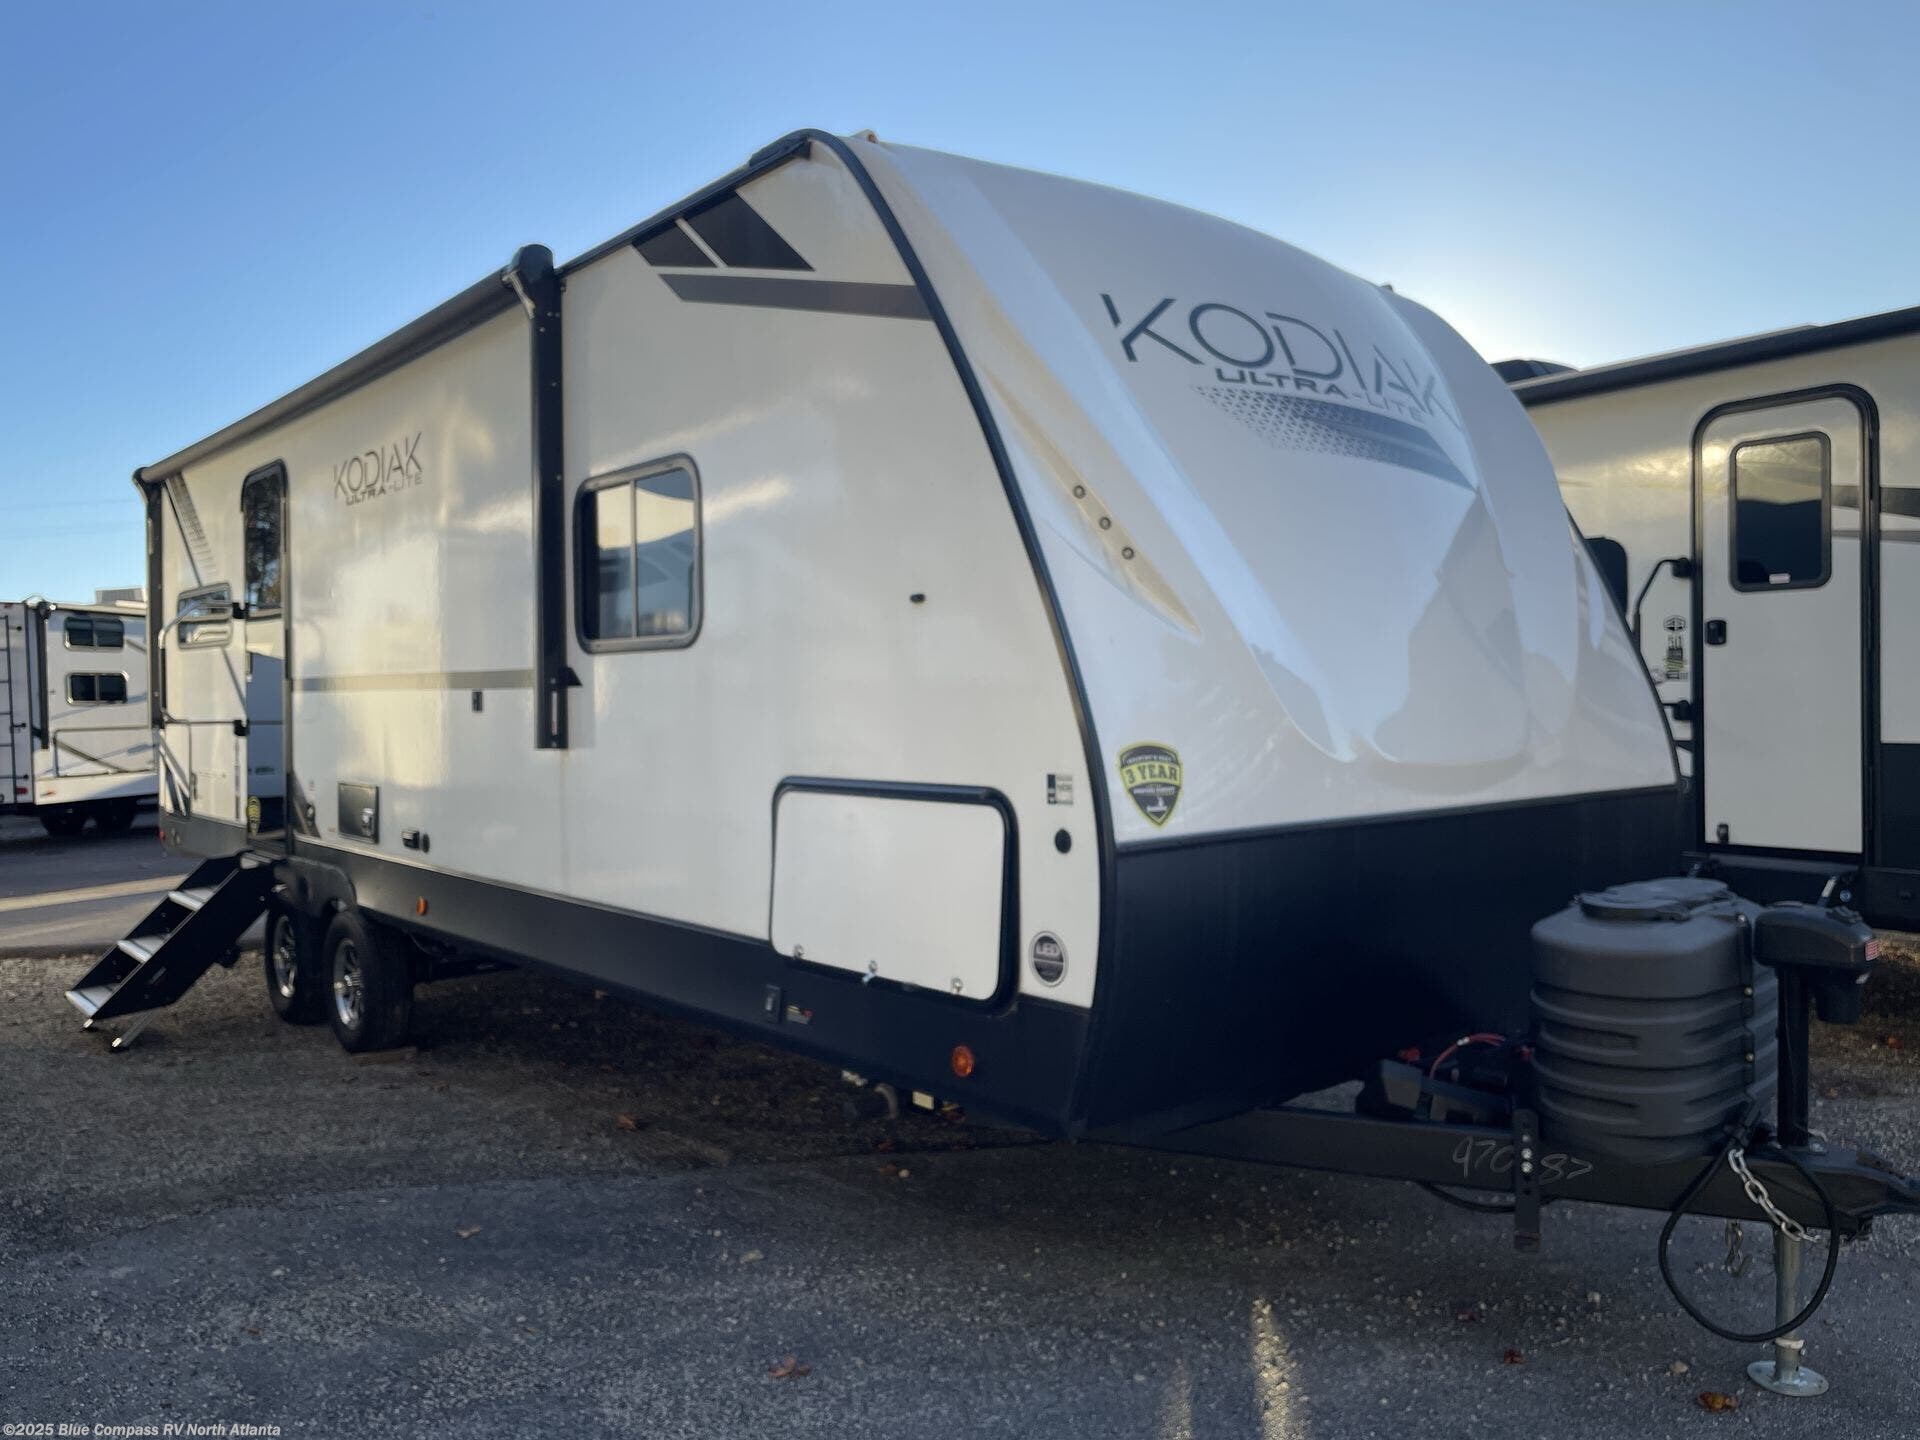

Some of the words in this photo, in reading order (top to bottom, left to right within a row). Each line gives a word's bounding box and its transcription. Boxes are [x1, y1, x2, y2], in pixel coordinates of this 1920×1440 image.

[1100, 292, 1464, 432] KODIAK
[332, 432, 423, 499] KODIAK
[1125, 768, 1136, 784] 3
[1137, 763, 1178, 782] YEAR
